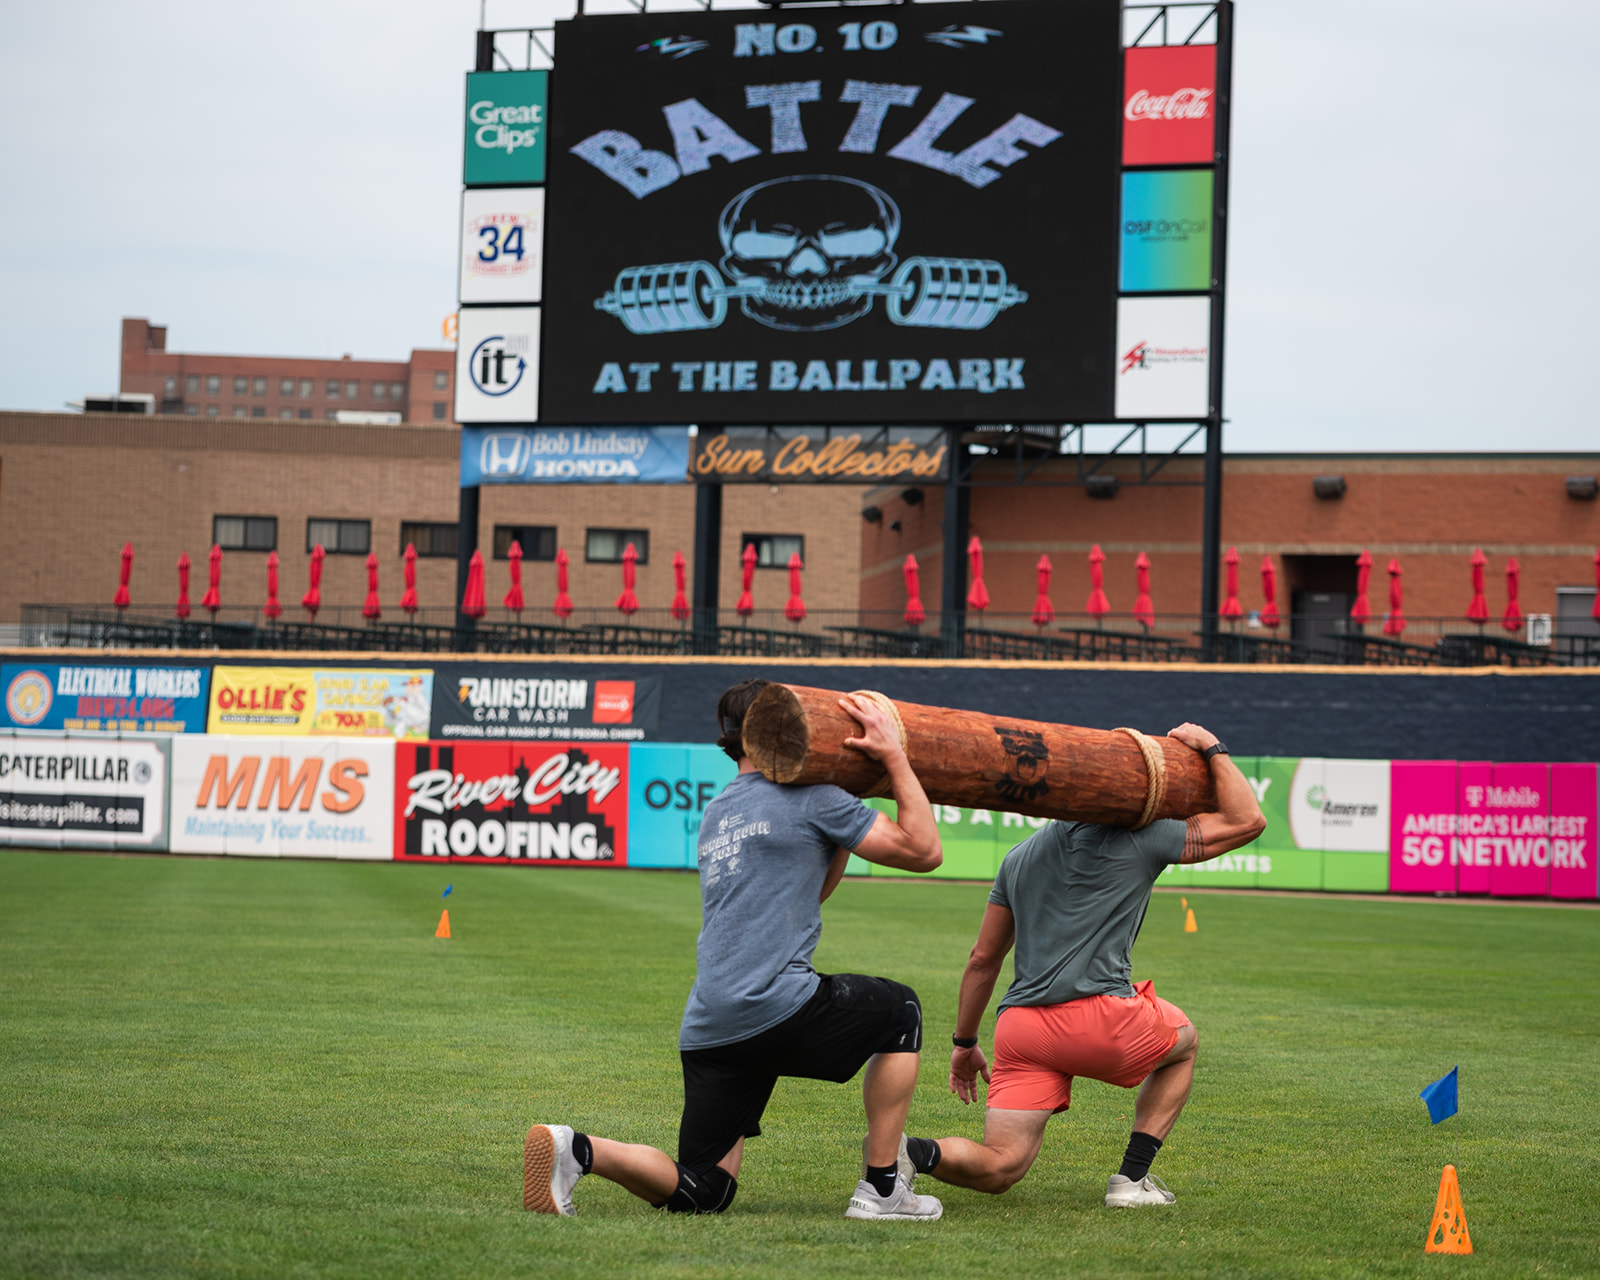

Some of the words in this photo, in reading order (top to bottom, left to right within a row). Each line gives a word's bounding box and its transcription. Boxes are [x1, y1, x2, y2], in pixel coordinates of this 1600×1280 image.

[733, 23, 824, 57] NO.
[838, 20, 899, 51] 10
[469, 100, 543, 126] Great
[1124, 87, 1215, 122] Coca-Cola
[474, 125, 536, 154] Clips
[569, 78, 1064, 200] BATTLE
[478, 225, 526, 262] 34
[593, 362, 660, 393] AT
[671, 361, 758, 392] THE
[768, 358, 1026, 393] BALLPARK
[532, 432, 570, 455] Bob
[573, 432, 649, 460] Lindsay
[696, 434, 766, 475] Sun
[772, 433, 948, 477] Collectors
[532, 459, 640, 477] HONDA
[57, 667, 132, 697] ELECTRICAL
[136, 669, 200, 698] WORKERS
[459, 677, 588, 709] RAINSTORM
[473, 708, 510, 722] CAR
[517, 709, 570, 723] WASH
[442, 725, 485, 737] OFFICIAL
[486, 726, 507, 738] CAR
[507, 727, 537, 738] WASH
[552, 727, 572, 738] THE
[609, 728, 646, 740] CHIEFS
[0, 753, 129, 782] CATERPILLAR
[195, 755, 369, 814] MMS
[404, 769, 521, 817] River
[522, 752, 620, 804] City
[644, 779, 716, 812] OSF
[1486, 786, 1540, 808] Mobile
[184, 815, 266, 844] Maintaining
[271, 819, 303, 840] Your
[420, 818, 598, 860] ROOFING
[1403, 813, 1511, 835] AMERICA'S
[1511, 815, 1588, 837] LARGEST
[1402, 837, 1444, 866] 5G
[1450, 838, 1588, 869] NETWORK
